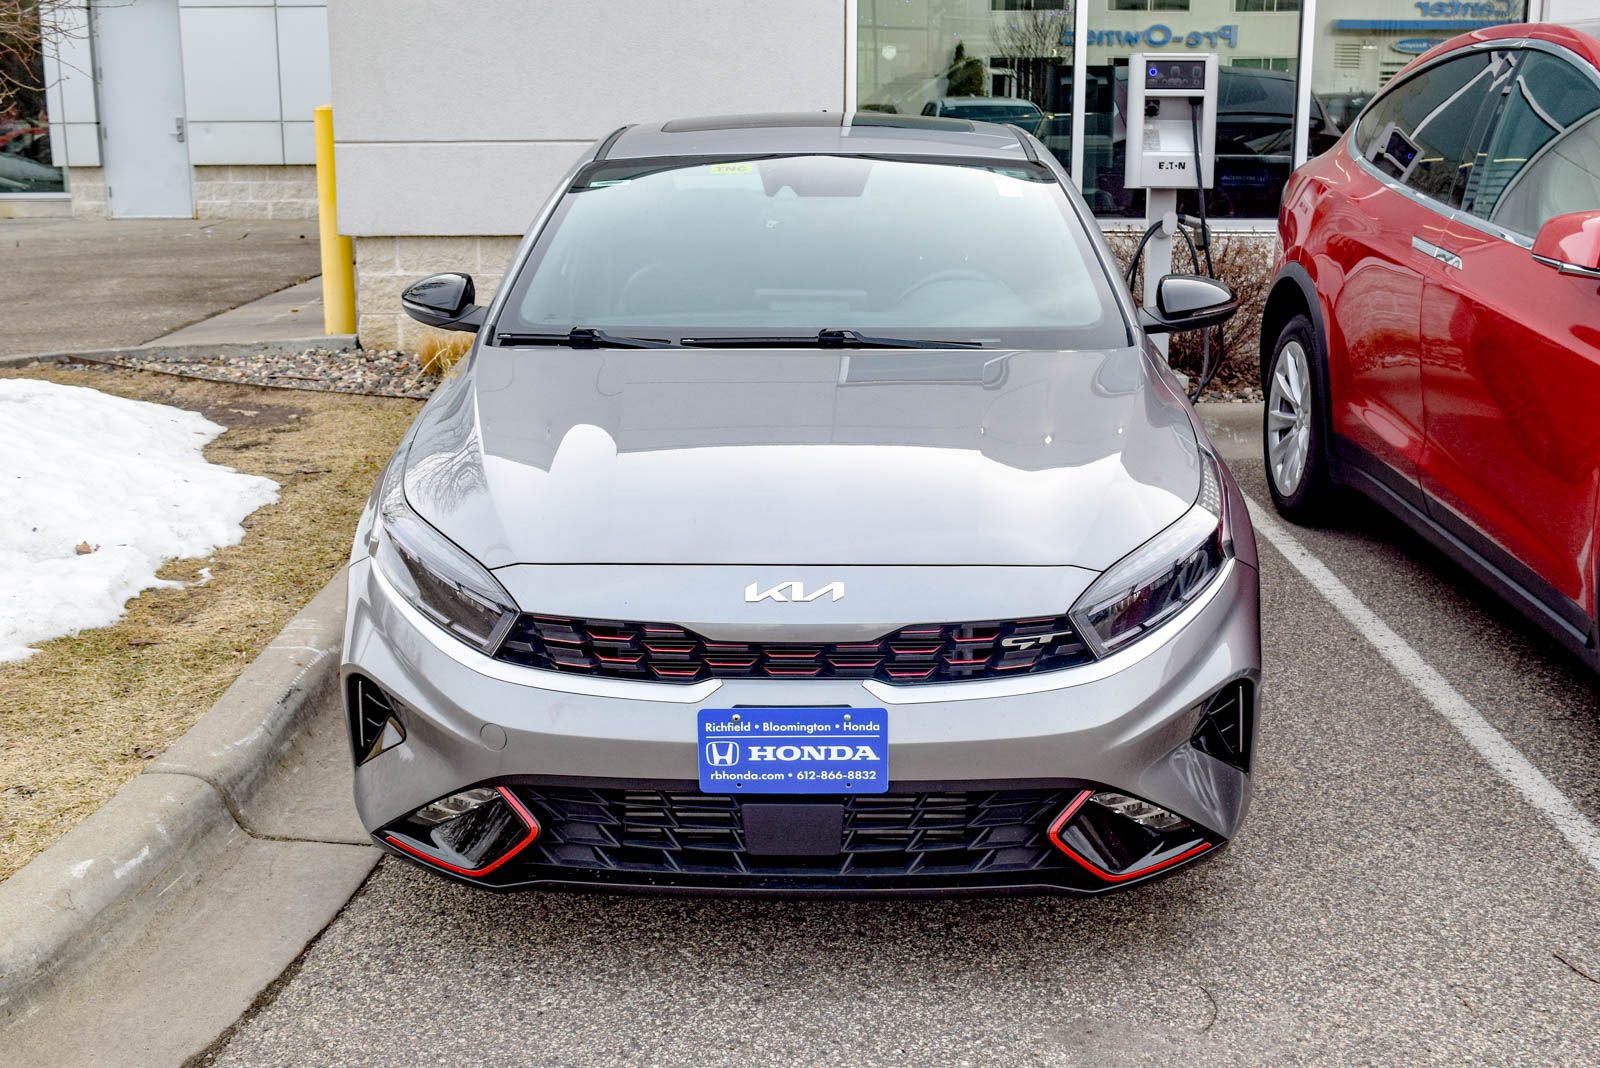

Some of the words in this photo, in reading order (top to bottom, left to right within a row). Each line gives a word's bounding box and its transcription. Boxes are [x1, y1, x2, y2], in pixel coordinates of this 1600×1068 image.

[744, 581, 845, 602] KIA
[1002, 630, 1073, 650] GT
[705, 722, 751, 733] Richfield
[762, 721, 832, 734] Bloomington
[843, 721, 881, 732] Honda
[748, 746, 881, 761] HONDA
[710, 770, 785, 781] rbhonda.com
[796, 770, 877, 781] 612-866-8832
